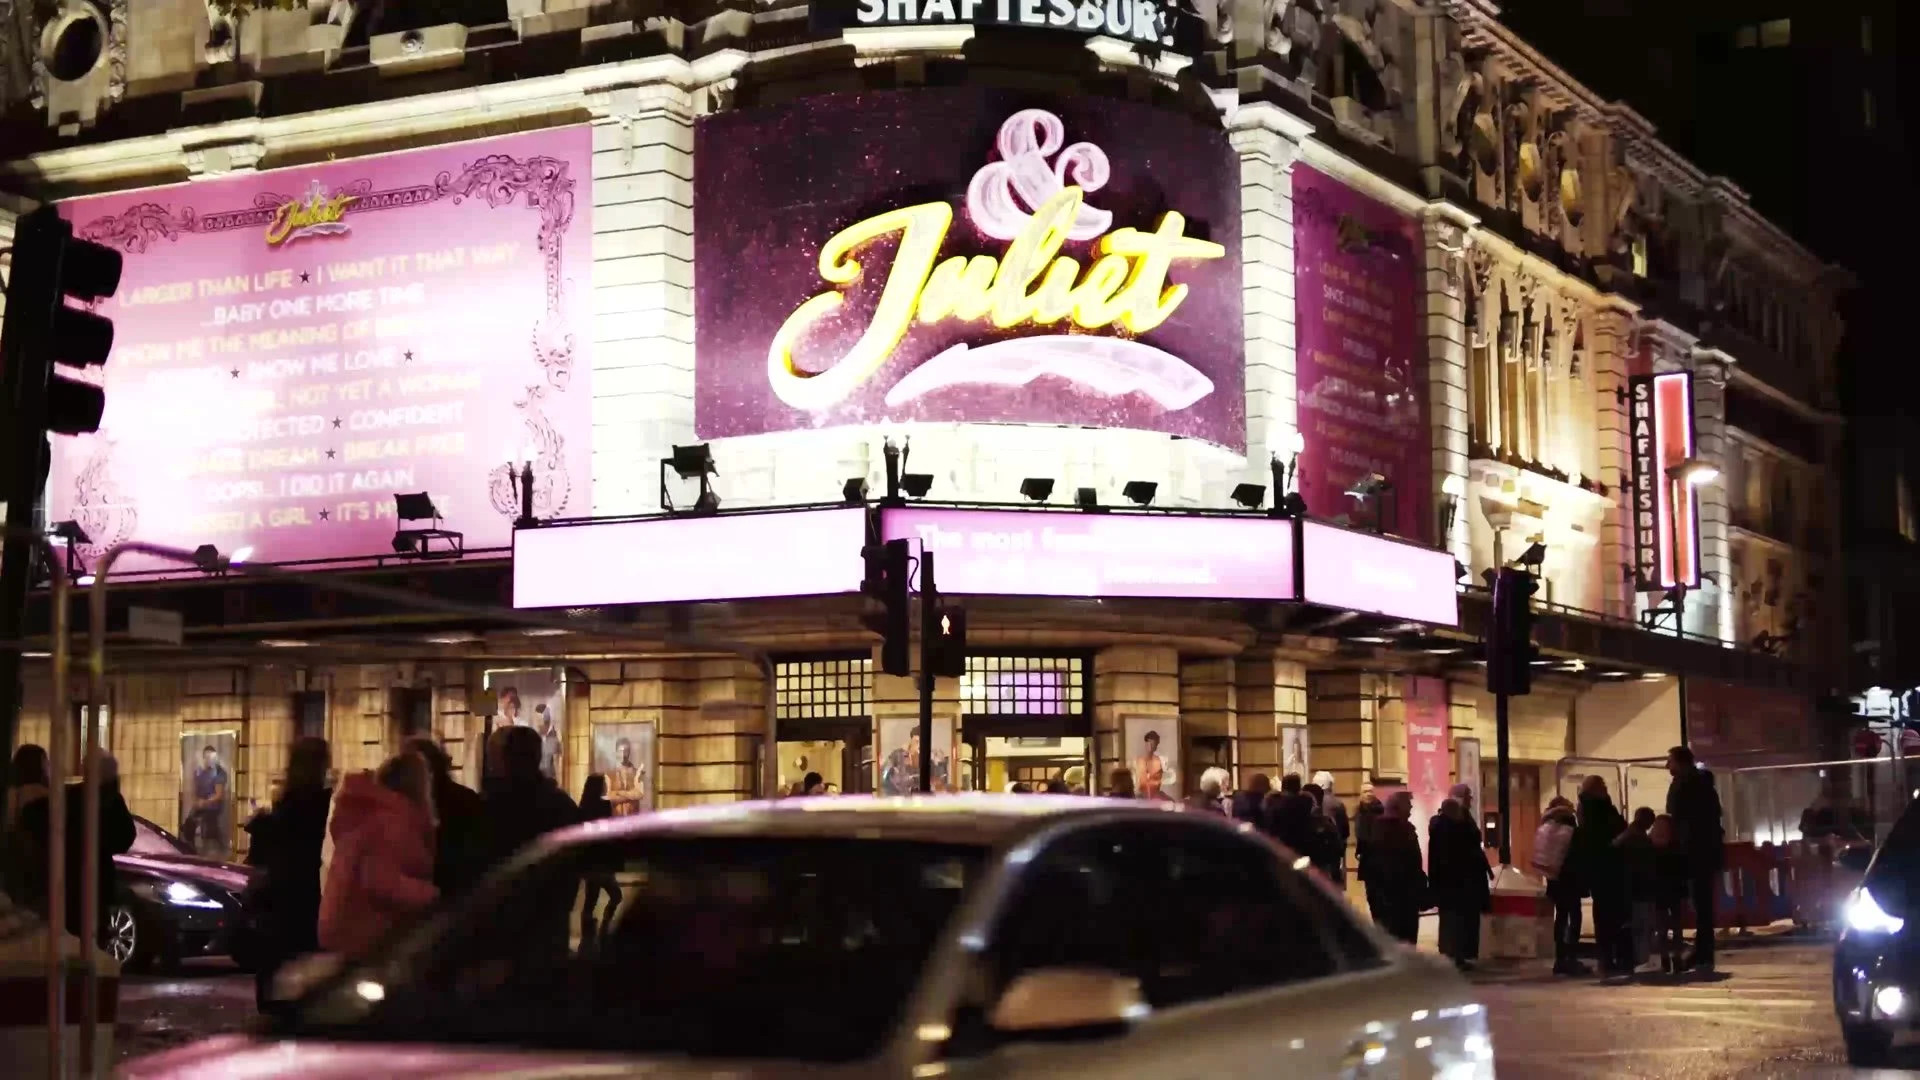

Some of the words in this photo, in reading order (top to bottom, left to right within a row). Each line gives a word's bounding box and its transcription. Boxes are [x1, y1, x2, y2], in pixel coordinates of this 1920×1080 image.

[966, 108, 1113, 241] &
[119, 284, 193, 307] LARGER
[198, 275, 250, 297] THAN
[254, 269, 294, 293] LIFE
[317, 265, 323, 285] I
[328, 258, 385, 282] WANT
[392, 255, 409, 273] IT
[416, 247, 465, 271] THAT
[270, 297, 311, 320] ONE
[316, 289, 374, 313] MORE
[767, 185, 1226, 412] Juliet
[311, 353, 339, 374] ME
[338, 378, 374, 402] YET
[350, 404, 465, 431] CONFIDENT
[329, 471, 345, 494] IT
[353, 467, 415, 489] AGAIN
[1635, 383, 1655, 583] SHAFTESBURY
[268, 506, 313, 528] GIRL
[337, 500, 370, 522] IT'S
